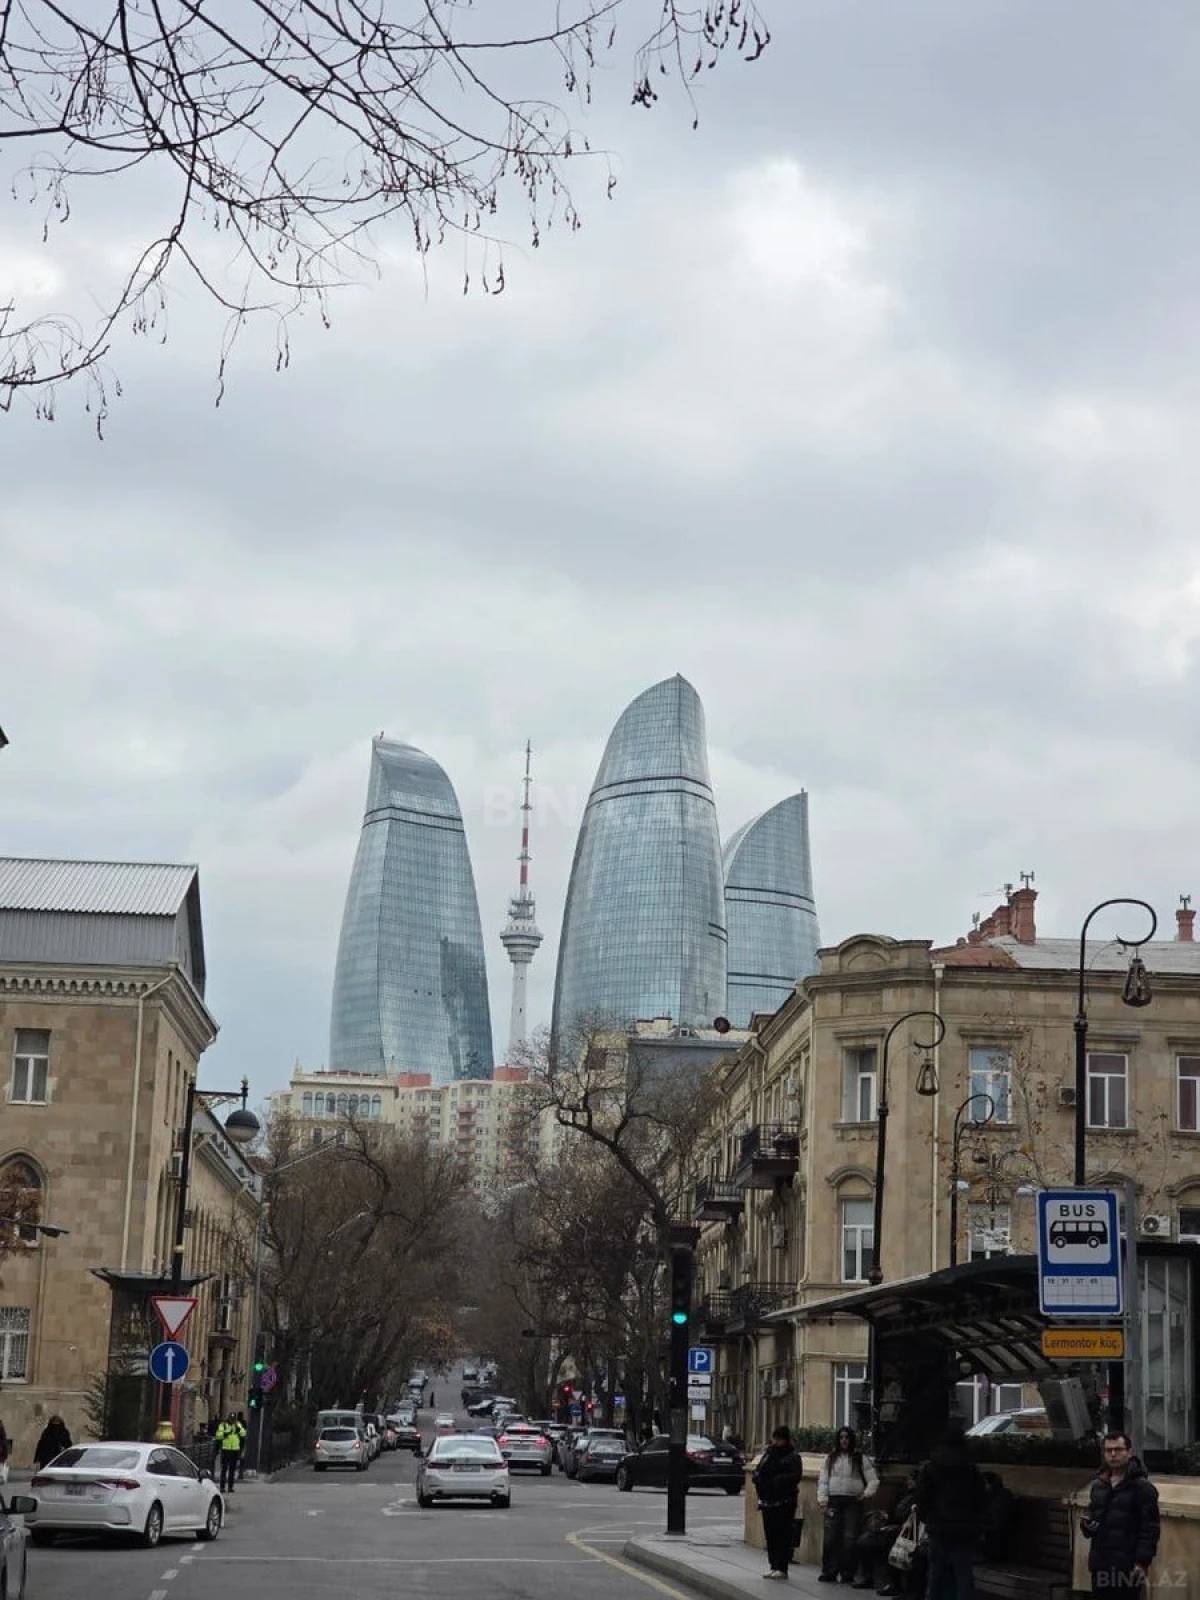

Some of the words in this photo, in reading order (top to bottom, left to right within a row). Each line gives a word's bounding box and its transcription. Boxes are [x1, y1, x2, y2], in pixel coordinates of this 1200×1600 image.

[1059, 1204, 1096, 1217] BUS
[1044, 1336, 1097, 1348] Lermontov
[695, 1351, 708, 1370] P
